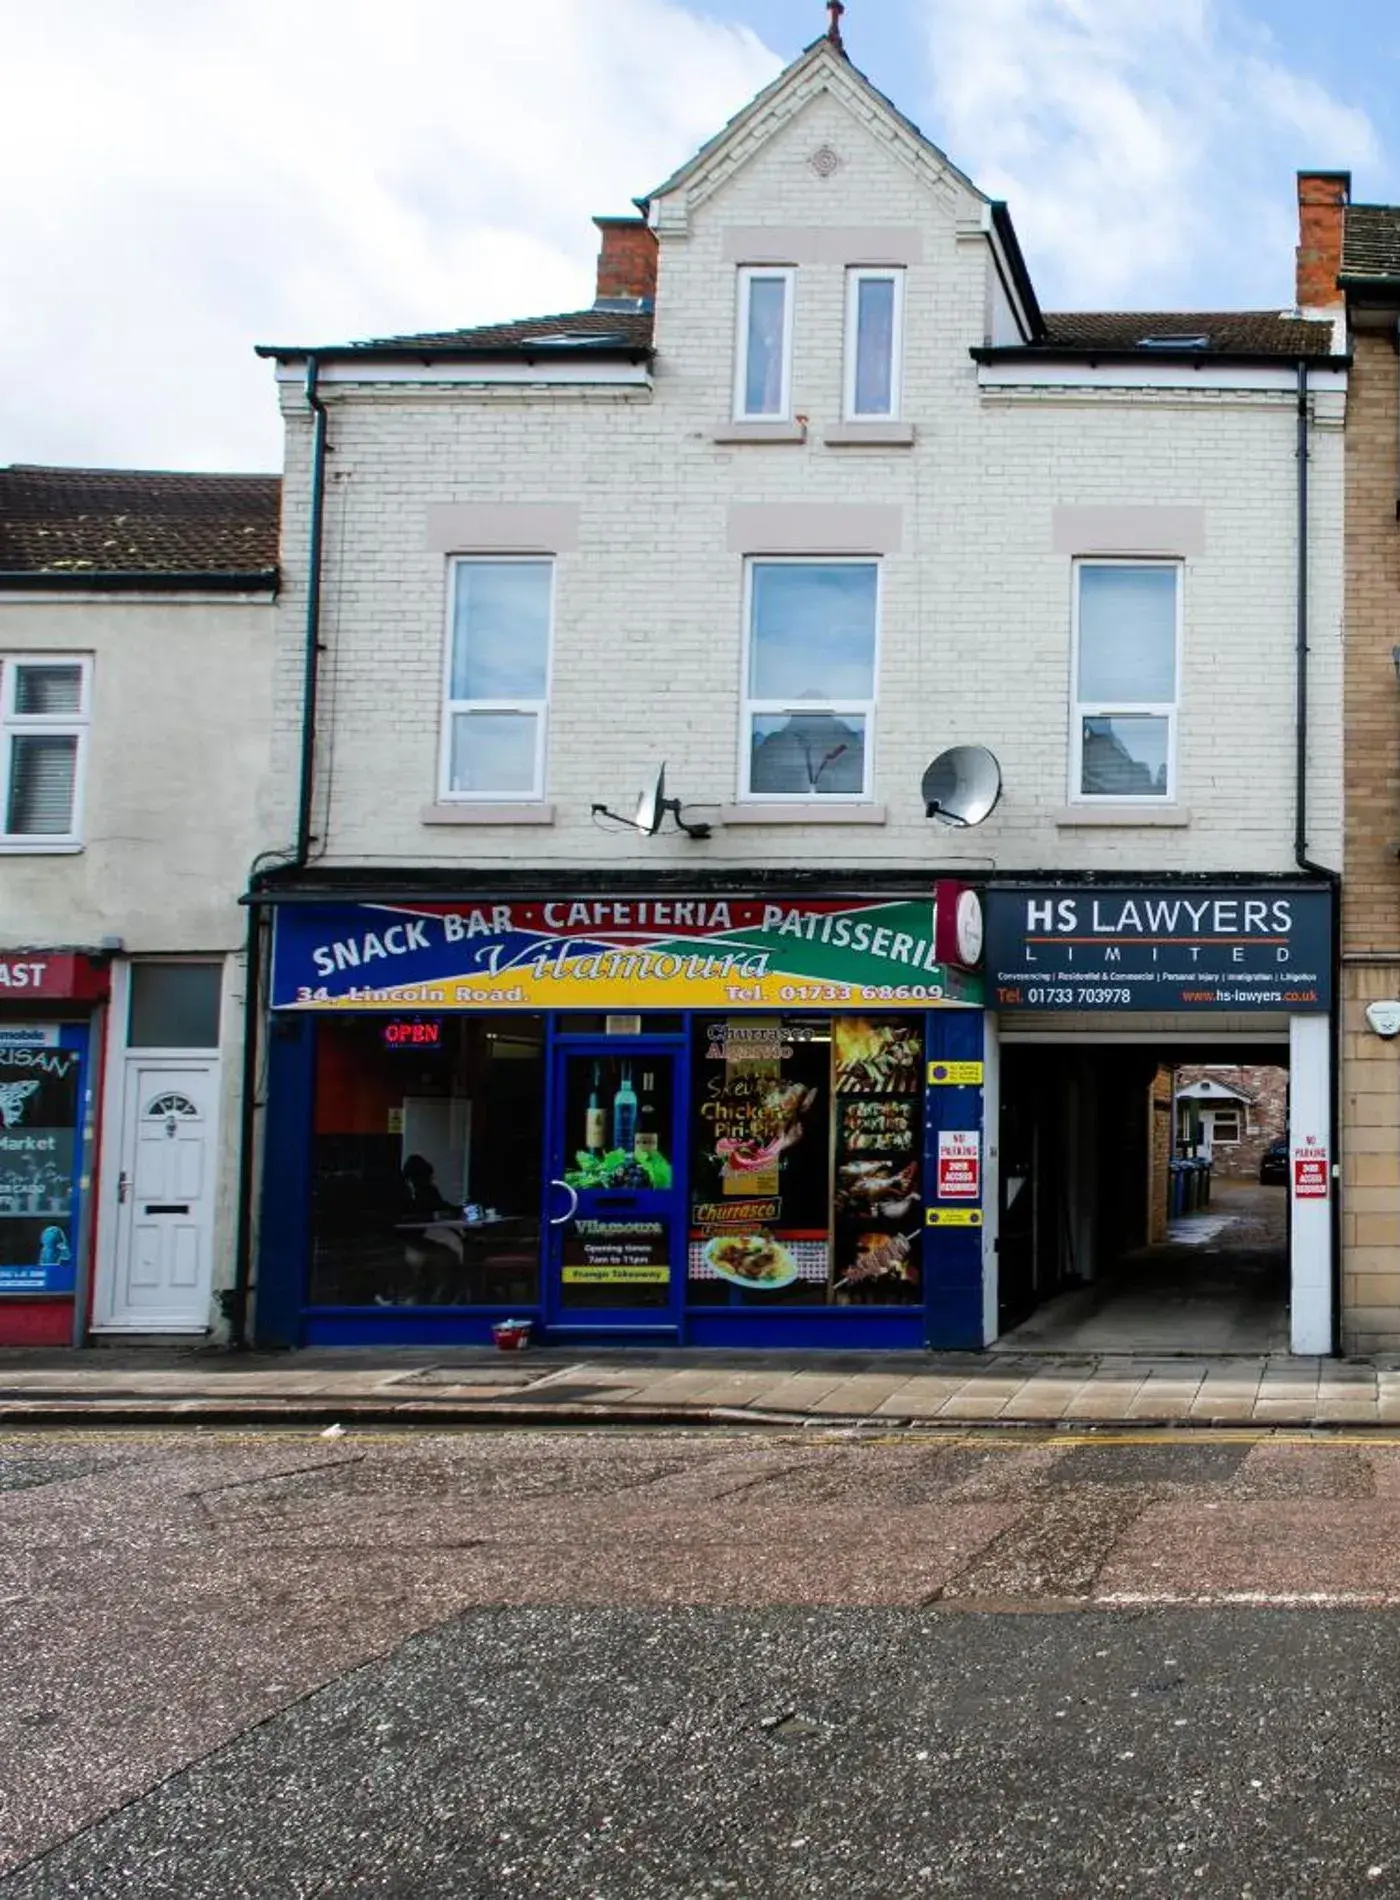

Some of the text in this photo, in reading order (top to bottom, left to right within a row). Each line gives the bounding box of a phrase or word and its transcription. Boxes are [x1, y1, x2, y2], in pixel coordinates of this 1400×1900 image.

[1026, 899, 1293, 933] HS LAWYERS
[313, 919, 431, 978] SNACK
[443, 905, 514, 943] BAR
[543, 902, 733, 929] CAFETERIA
[474, 937, 773, 981] Vilamoura
[1025, 946, 1290, 963] LIMITED
[350, 985, 445, 1002] Lincoln
[455, 985, 531, 1002] Road.
[725, 984, 958, 1002] Tel. 01733 68609
[1027, 988, 1073, 1004] 01733
[1077, 988, 1131, 1004] 703978
[1182, 988, 1317, 1004] www.hs-lawyers.co.uk
[385, 1023, 440, 1044] OPEN
